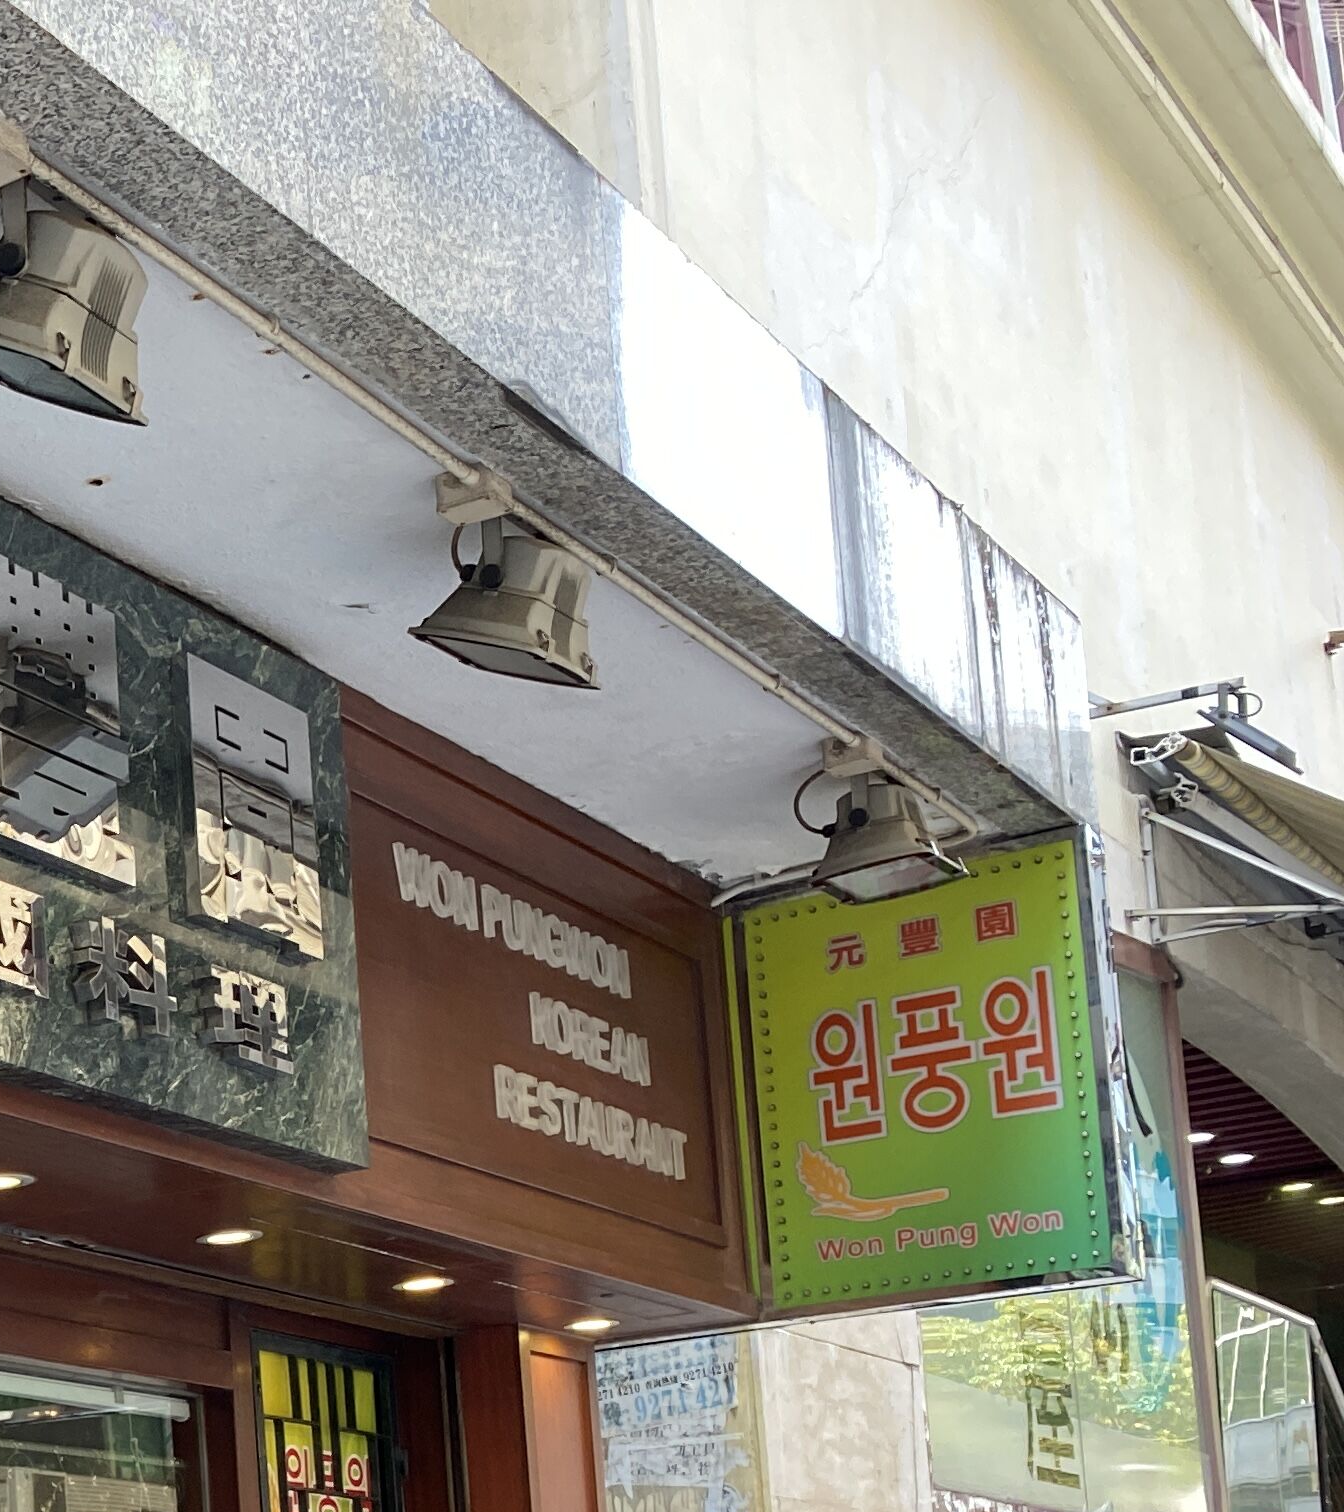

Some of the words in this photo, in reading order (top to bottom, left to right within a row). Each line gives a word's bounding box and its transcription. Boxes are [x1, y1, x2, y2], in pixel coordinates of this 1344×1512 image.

[391, 840, 480, 932] WON
[826, 901, 1018, 974] 元豐園
[528, 990, 652, 1087] KOREAN
[809, 964, 1064, 1147] 원풍원
[492, 1062, 688, 1181] RESTAURANT
[816, 1233, 886, 1263] Won
[895, 1221, 978, 1256] Pung
[986, 1207, 1064, 1239] Won
